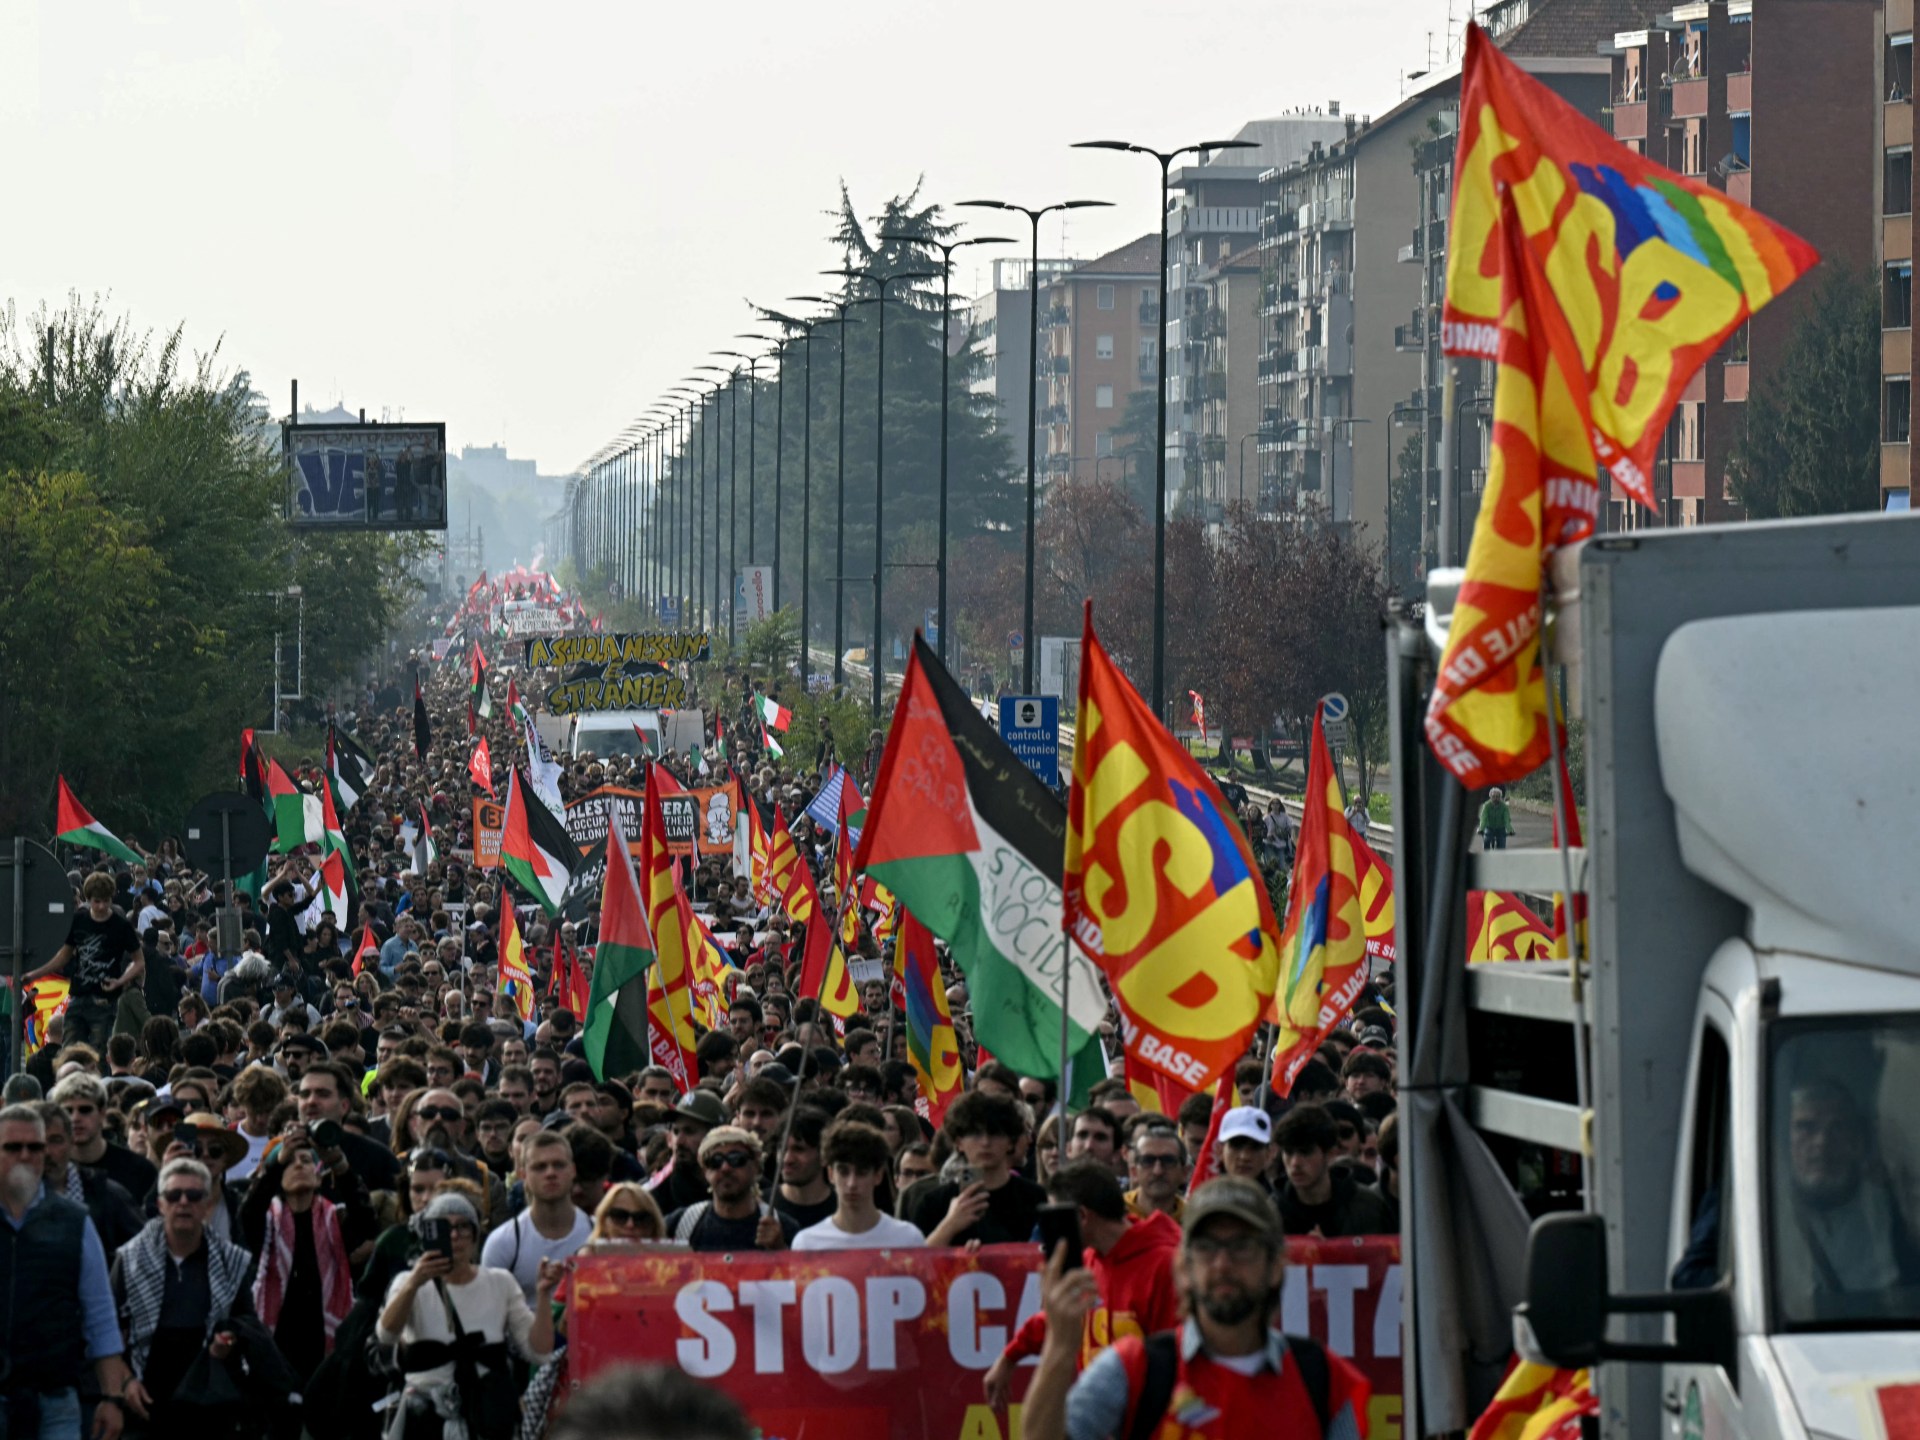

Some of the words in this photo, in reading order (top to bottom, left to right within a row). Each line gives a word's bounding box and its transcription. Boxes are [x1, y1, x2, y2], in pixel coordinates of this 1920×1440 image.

[550, 634, 620, 667] SCUOLA
[1007, 729, 1051, 740] controllo
[567, 798, 636, 822] ALESTNA
[1138, 1034, 1210, 1086] BASE
[675, 1274, 926, 1380] STOP
